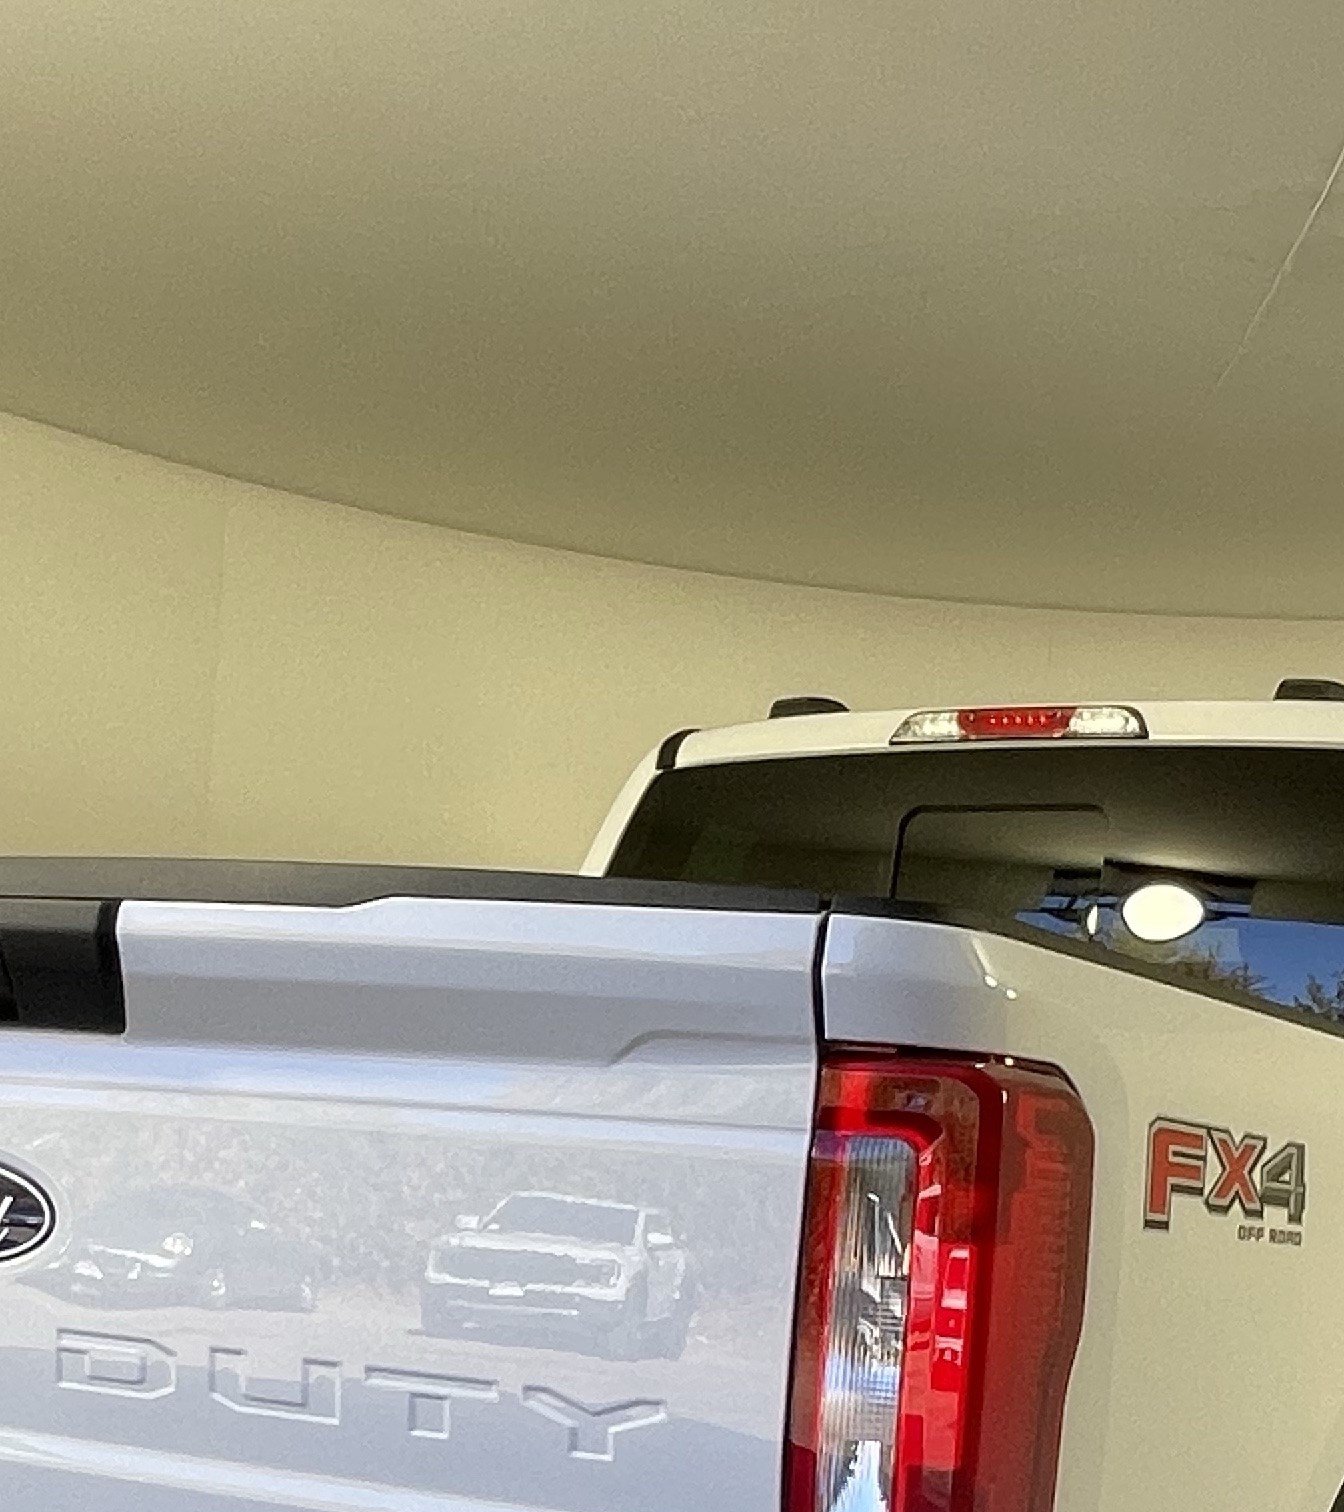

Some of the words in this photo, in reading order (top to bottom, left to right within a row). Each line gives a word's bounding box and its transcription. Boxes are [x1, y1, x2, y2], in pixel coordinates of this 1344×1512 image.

[1143, 1116, 1305, 1231] FX4
[1237, 1224, 1264, 1242] OFF
[1268, 1228, 1302, 1246] ROAD
[56, 1328, 668, 1461] DUTY
